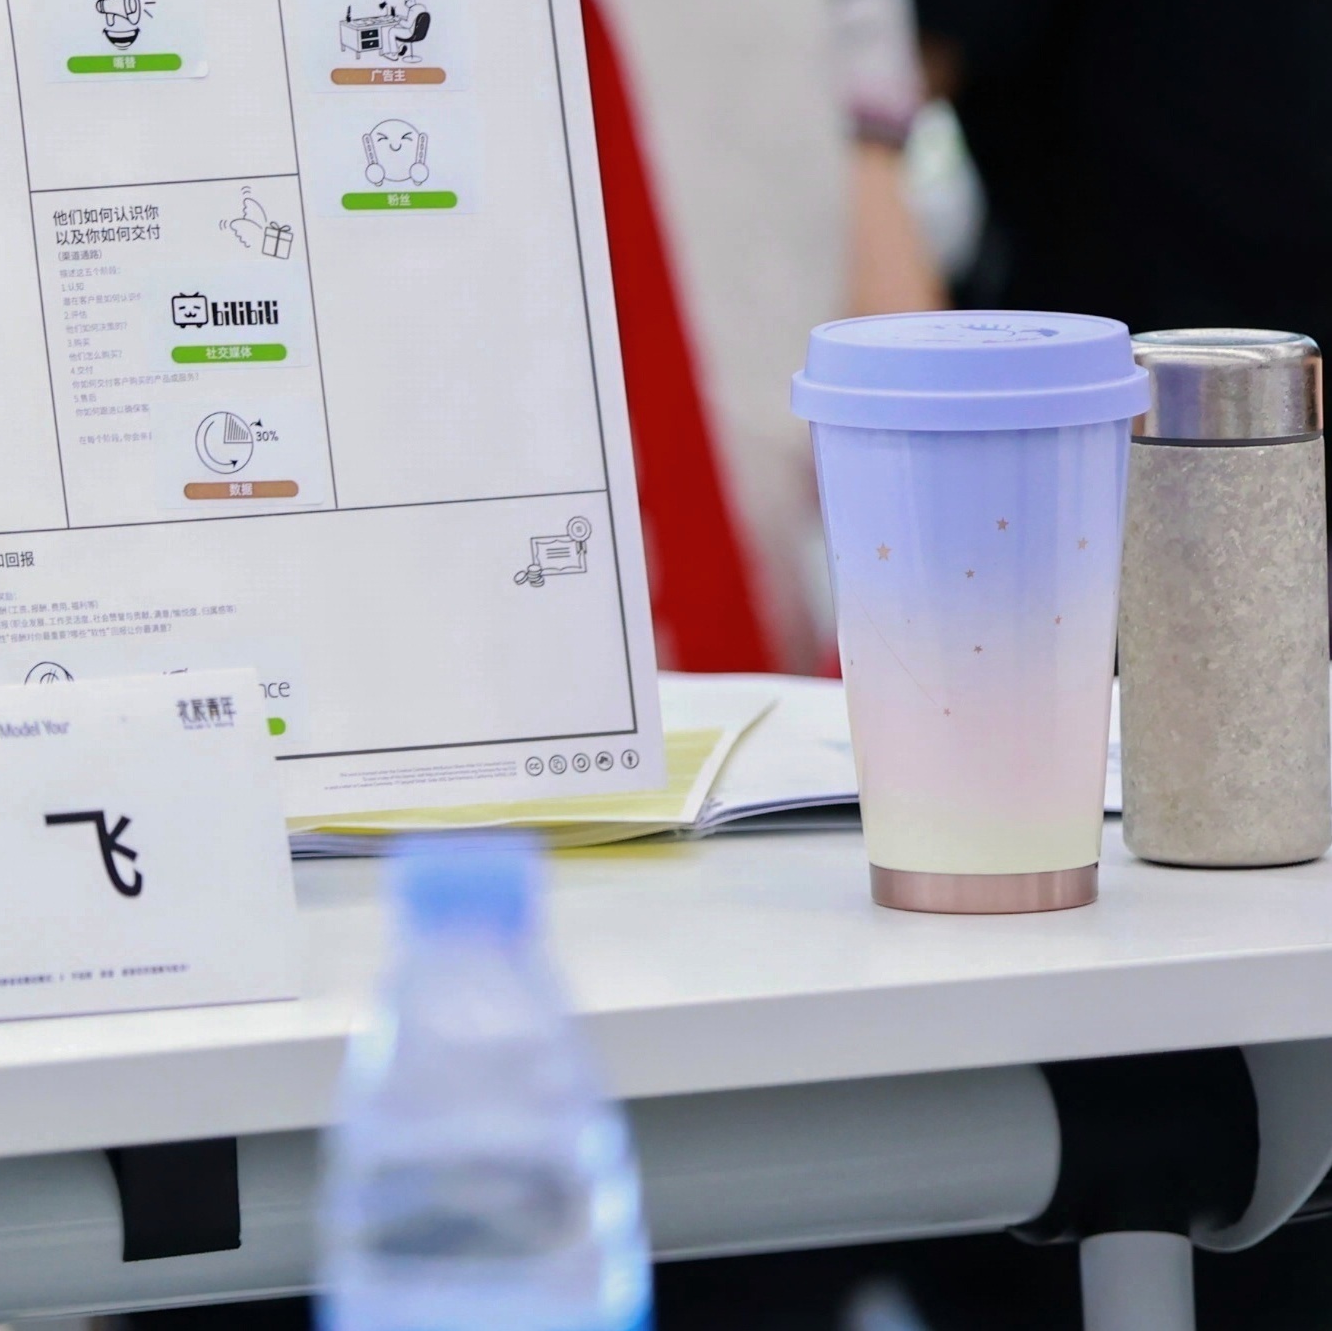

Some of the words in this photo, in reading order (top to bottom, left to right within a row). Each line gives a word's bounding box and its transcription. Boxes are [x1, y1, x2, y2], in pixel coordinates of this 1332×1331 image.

[370, 69, 407, 82] 广告主
[387, 193, 412, 206] 粉丝
[53, 204, 160, 227] 他们如何认识你
[55, 224, 161, 246] 以及你如何交付
[211, 301, 279, 327] bilibili
[206, 346, 252, 360] 社交媒体
[255, 430, 279, 443] 30%
[229, 483, 253, 497] 数据
[43, 808, 144, 899] 飞
